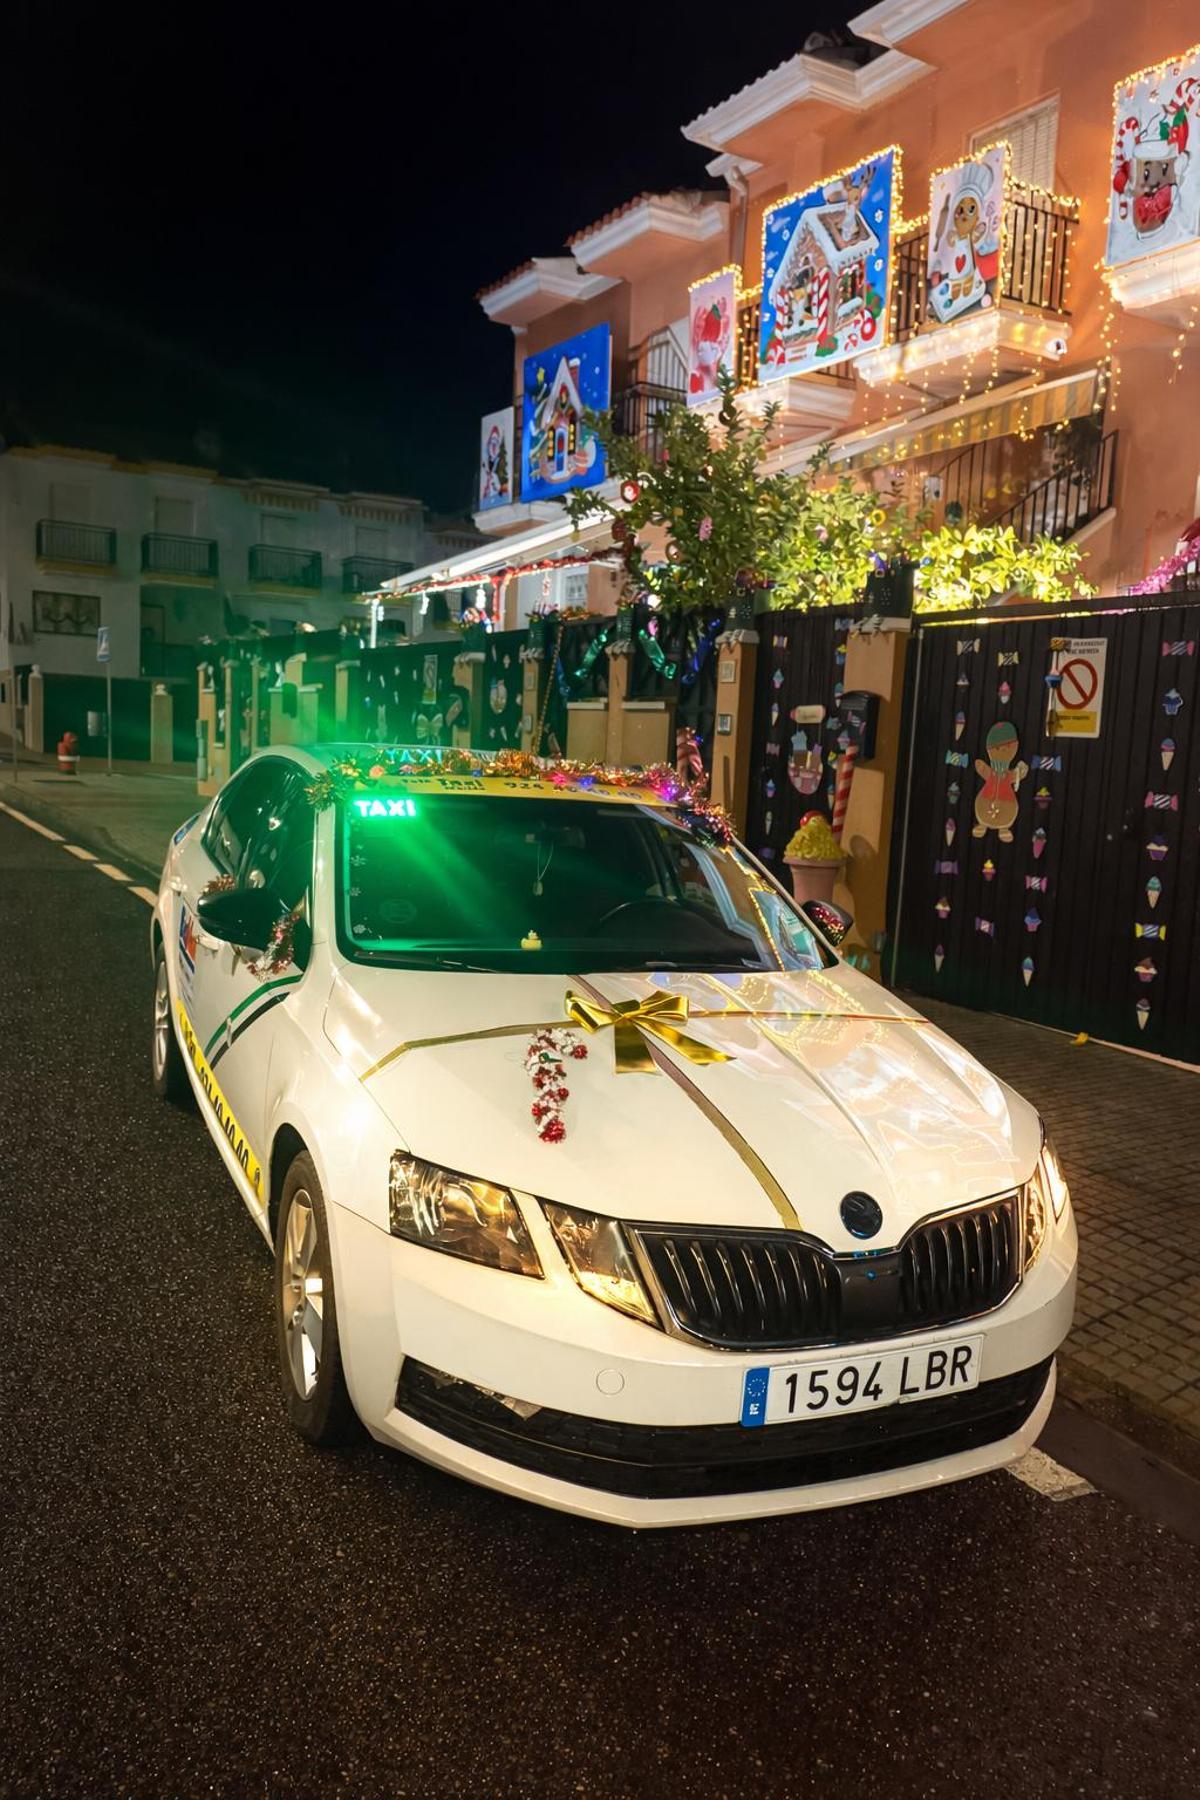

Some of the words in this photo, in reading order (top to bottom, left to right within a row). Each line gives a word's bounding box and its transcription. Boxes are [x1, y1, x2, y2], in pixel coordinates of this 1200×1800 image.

[353, 799, 416, 817] TAXI
[785, 1361, 883, 1414] 1594
[899, 1345, 972, 1396] LBR
